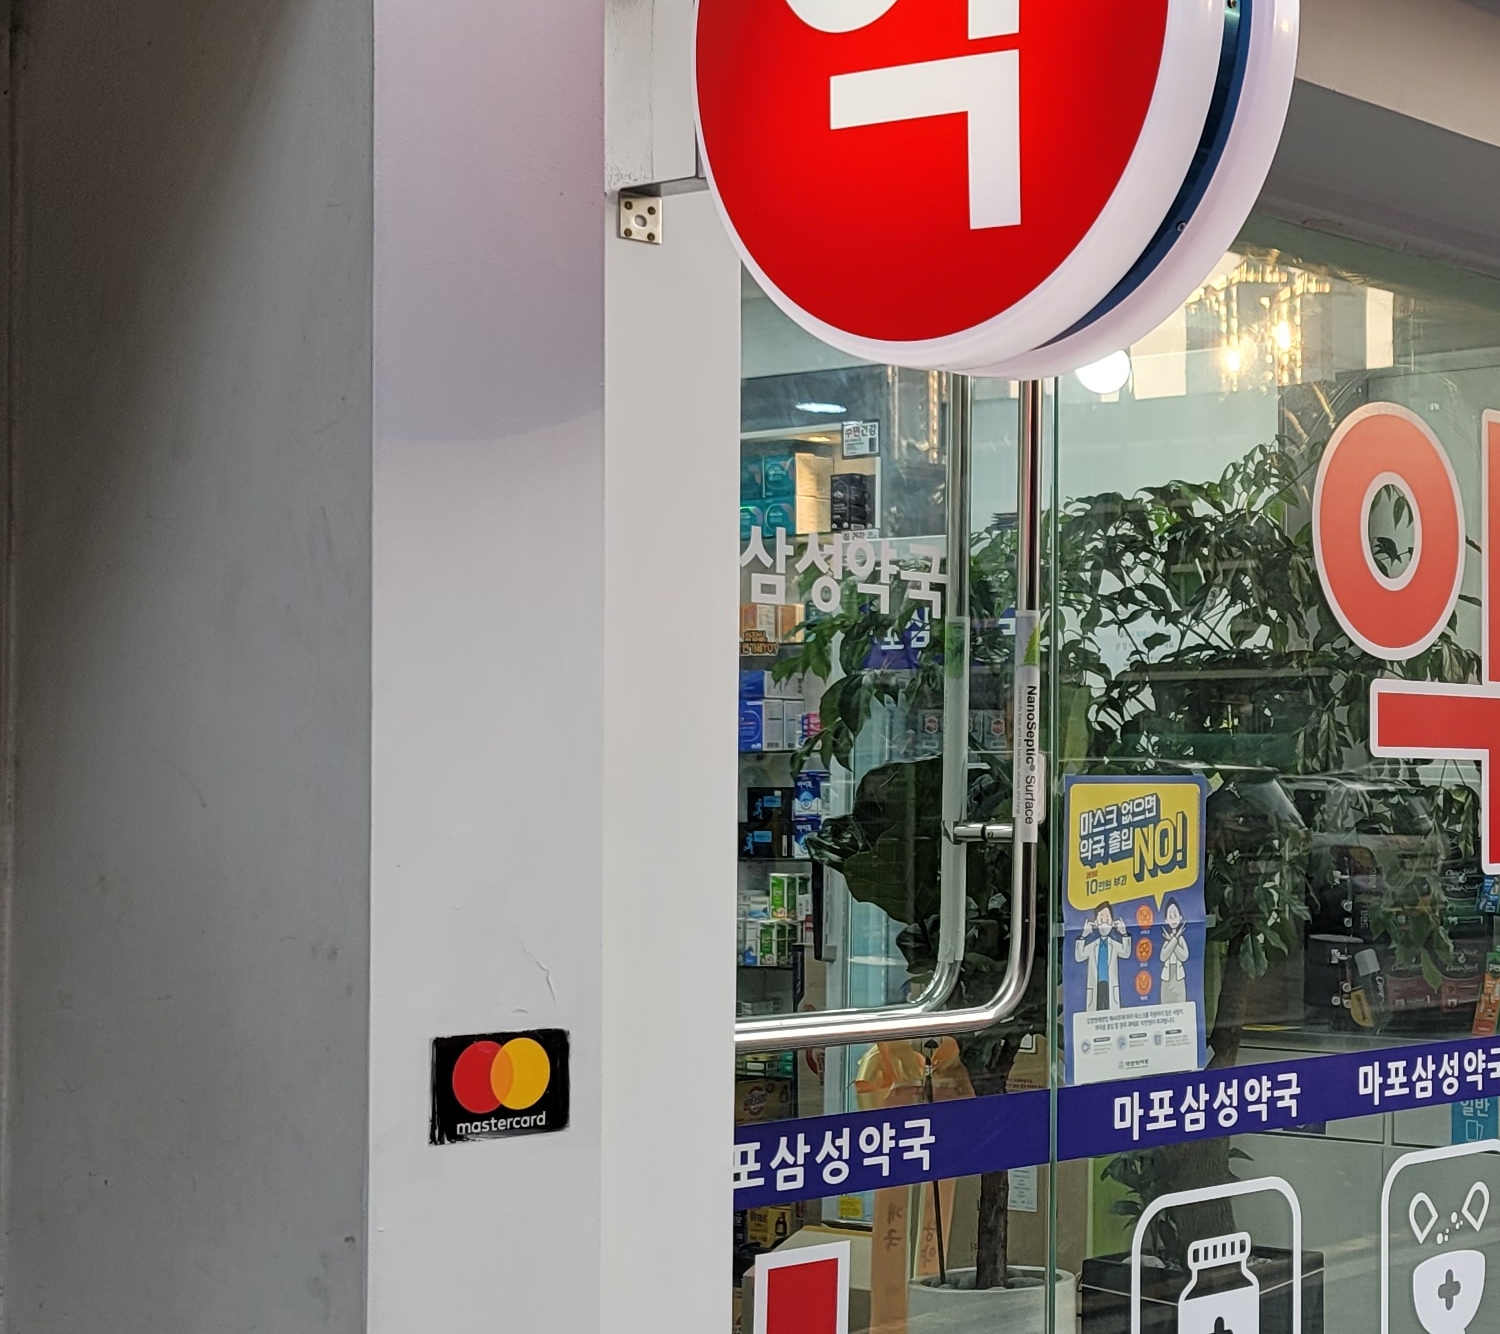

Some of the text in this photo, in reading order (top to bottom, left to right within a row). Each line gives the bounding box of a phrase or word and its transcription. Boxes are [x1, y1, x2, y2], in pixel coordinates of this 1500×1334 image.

[740, 525, 949, 619] 삼성약국
[1023, 773, 1036, 825] Surface
[1080, 793, 1157, 837] 마스크 없으면
[1080, 812, 1184, 876] 약국 출입 NO!
[455, 1110, 546, 1135] mastercard
[1113, 1072, 1301, 1140] 마포삼성약국
[733, 1118, 936, 1192] 포삼성약국
